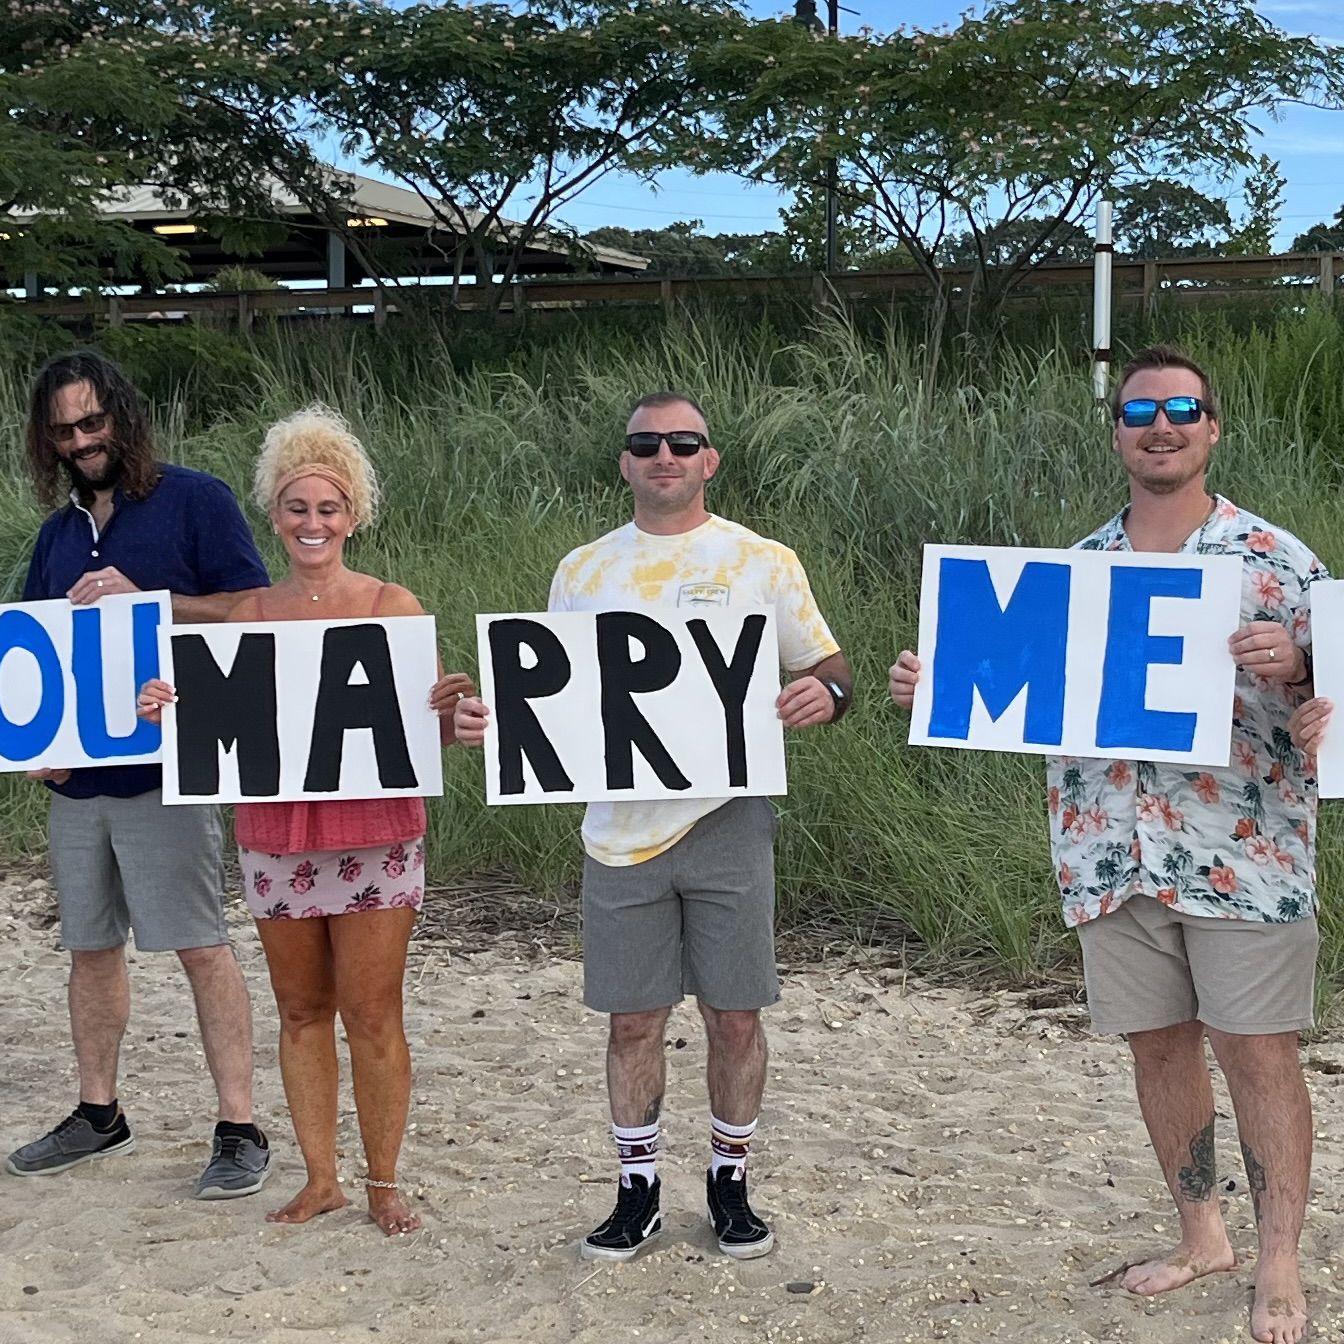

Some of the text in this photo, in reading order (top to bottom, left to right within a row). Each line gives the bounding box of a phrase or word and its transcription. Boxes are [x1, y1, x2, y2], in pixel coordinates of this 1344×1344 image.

[170, 622, 419, 797] MA
[487, 611, 767, 796] RRY
[927, 556, 1204, 754] ME
